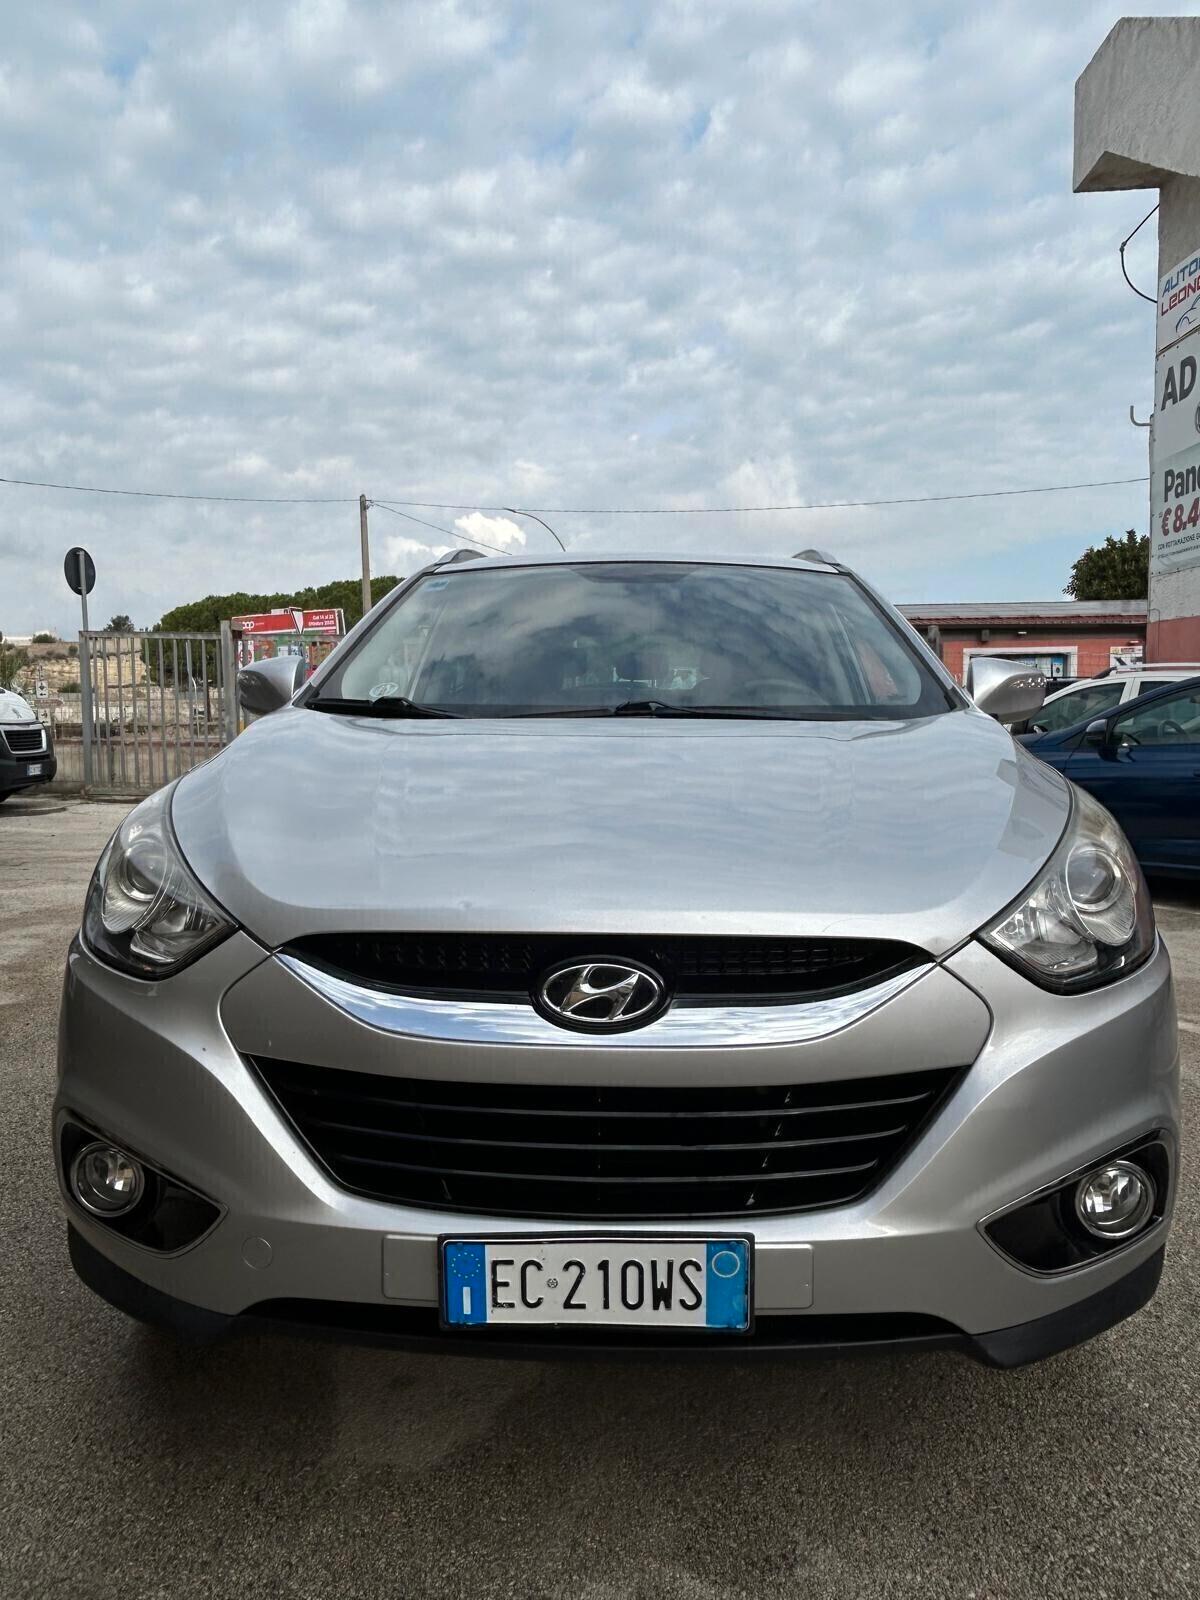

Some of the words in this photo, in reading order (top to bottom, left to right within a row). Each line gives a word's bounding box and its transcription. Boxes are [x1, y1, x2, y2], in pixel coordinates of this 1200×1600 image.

[1162, 257, 1200, 298] AUTO
[1161, 355, 1197, 412] AD
[491, 1259, 544, 1309] EC
[562, 1259, 703, 1311] 210WS
